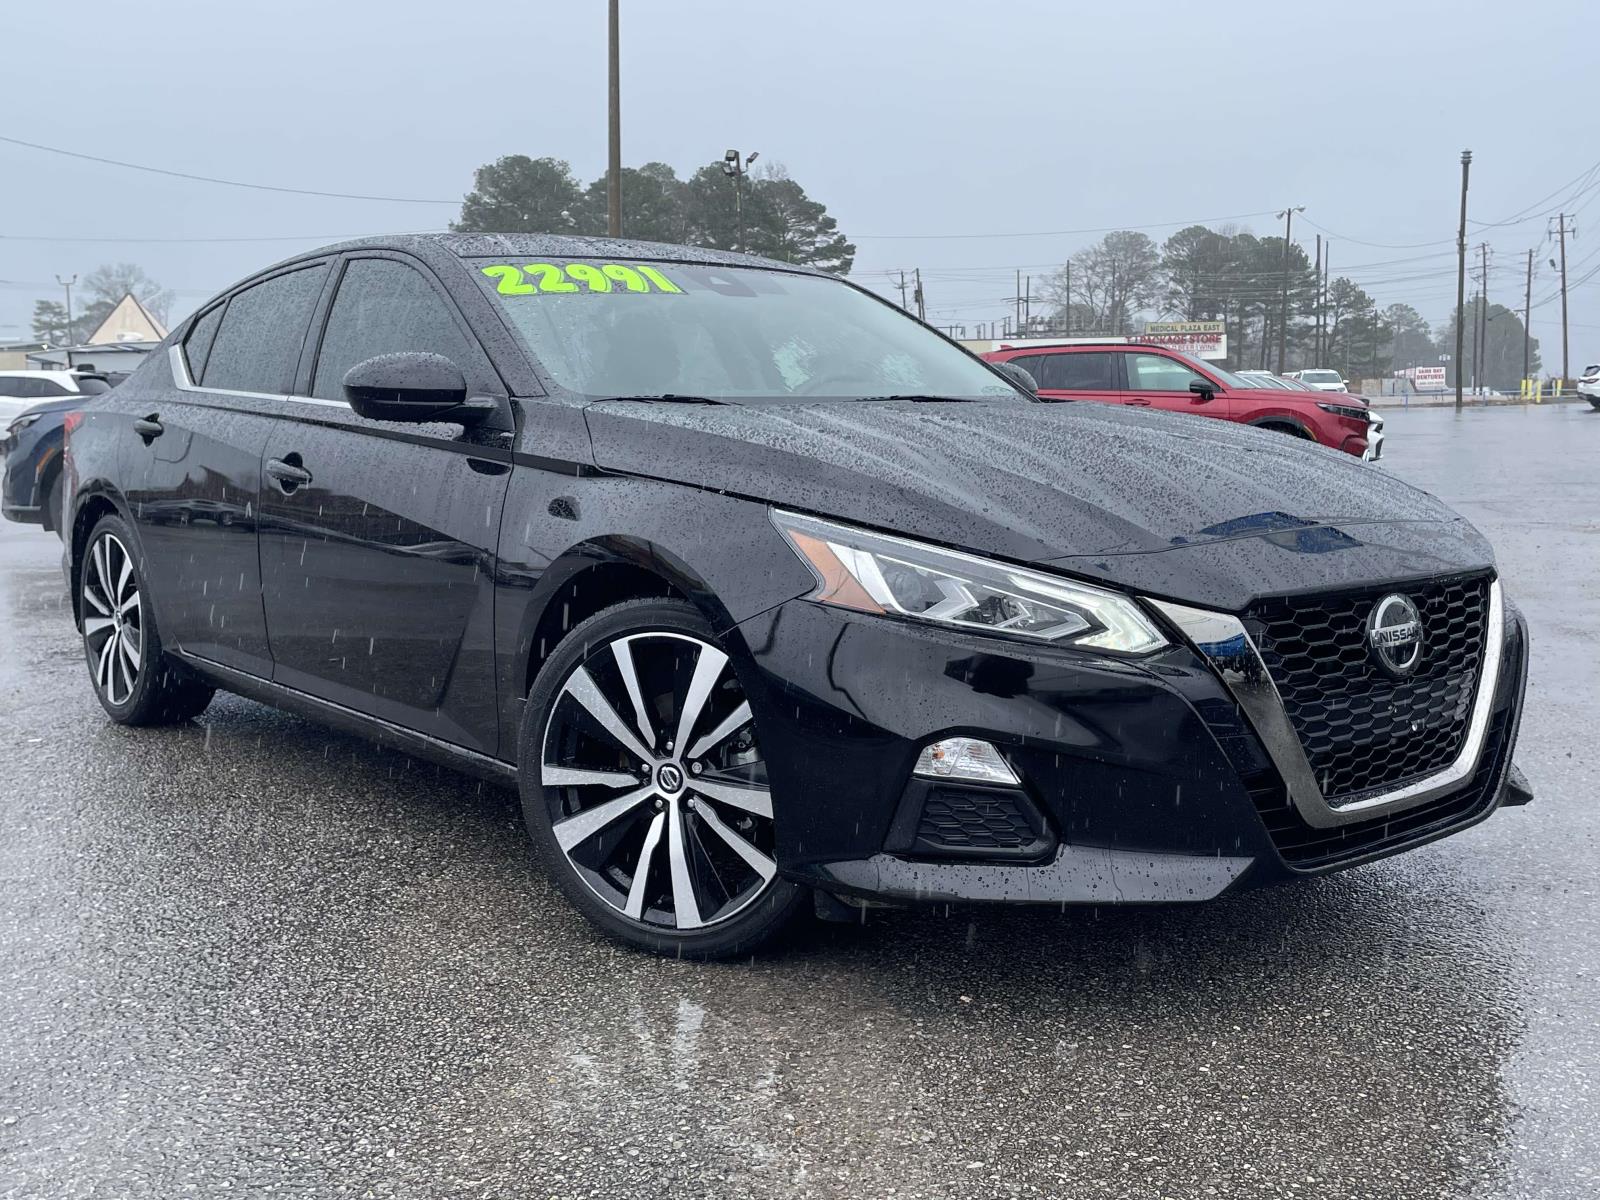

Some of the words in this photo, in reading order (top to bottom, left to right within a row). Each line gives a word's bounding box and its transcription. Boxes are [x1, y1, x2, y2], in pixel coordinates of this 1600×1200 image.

[482, 263, 684, 295] 22991
[1180, 324, 1201, 332] PLAZA
[1203, 324, 1220, 332] EAST
[1140, 334, 1186, 344] PACKAGE
[1188, 333, 1222, 344] STORE
[1379, 626, 1420, 642] NISSAN
